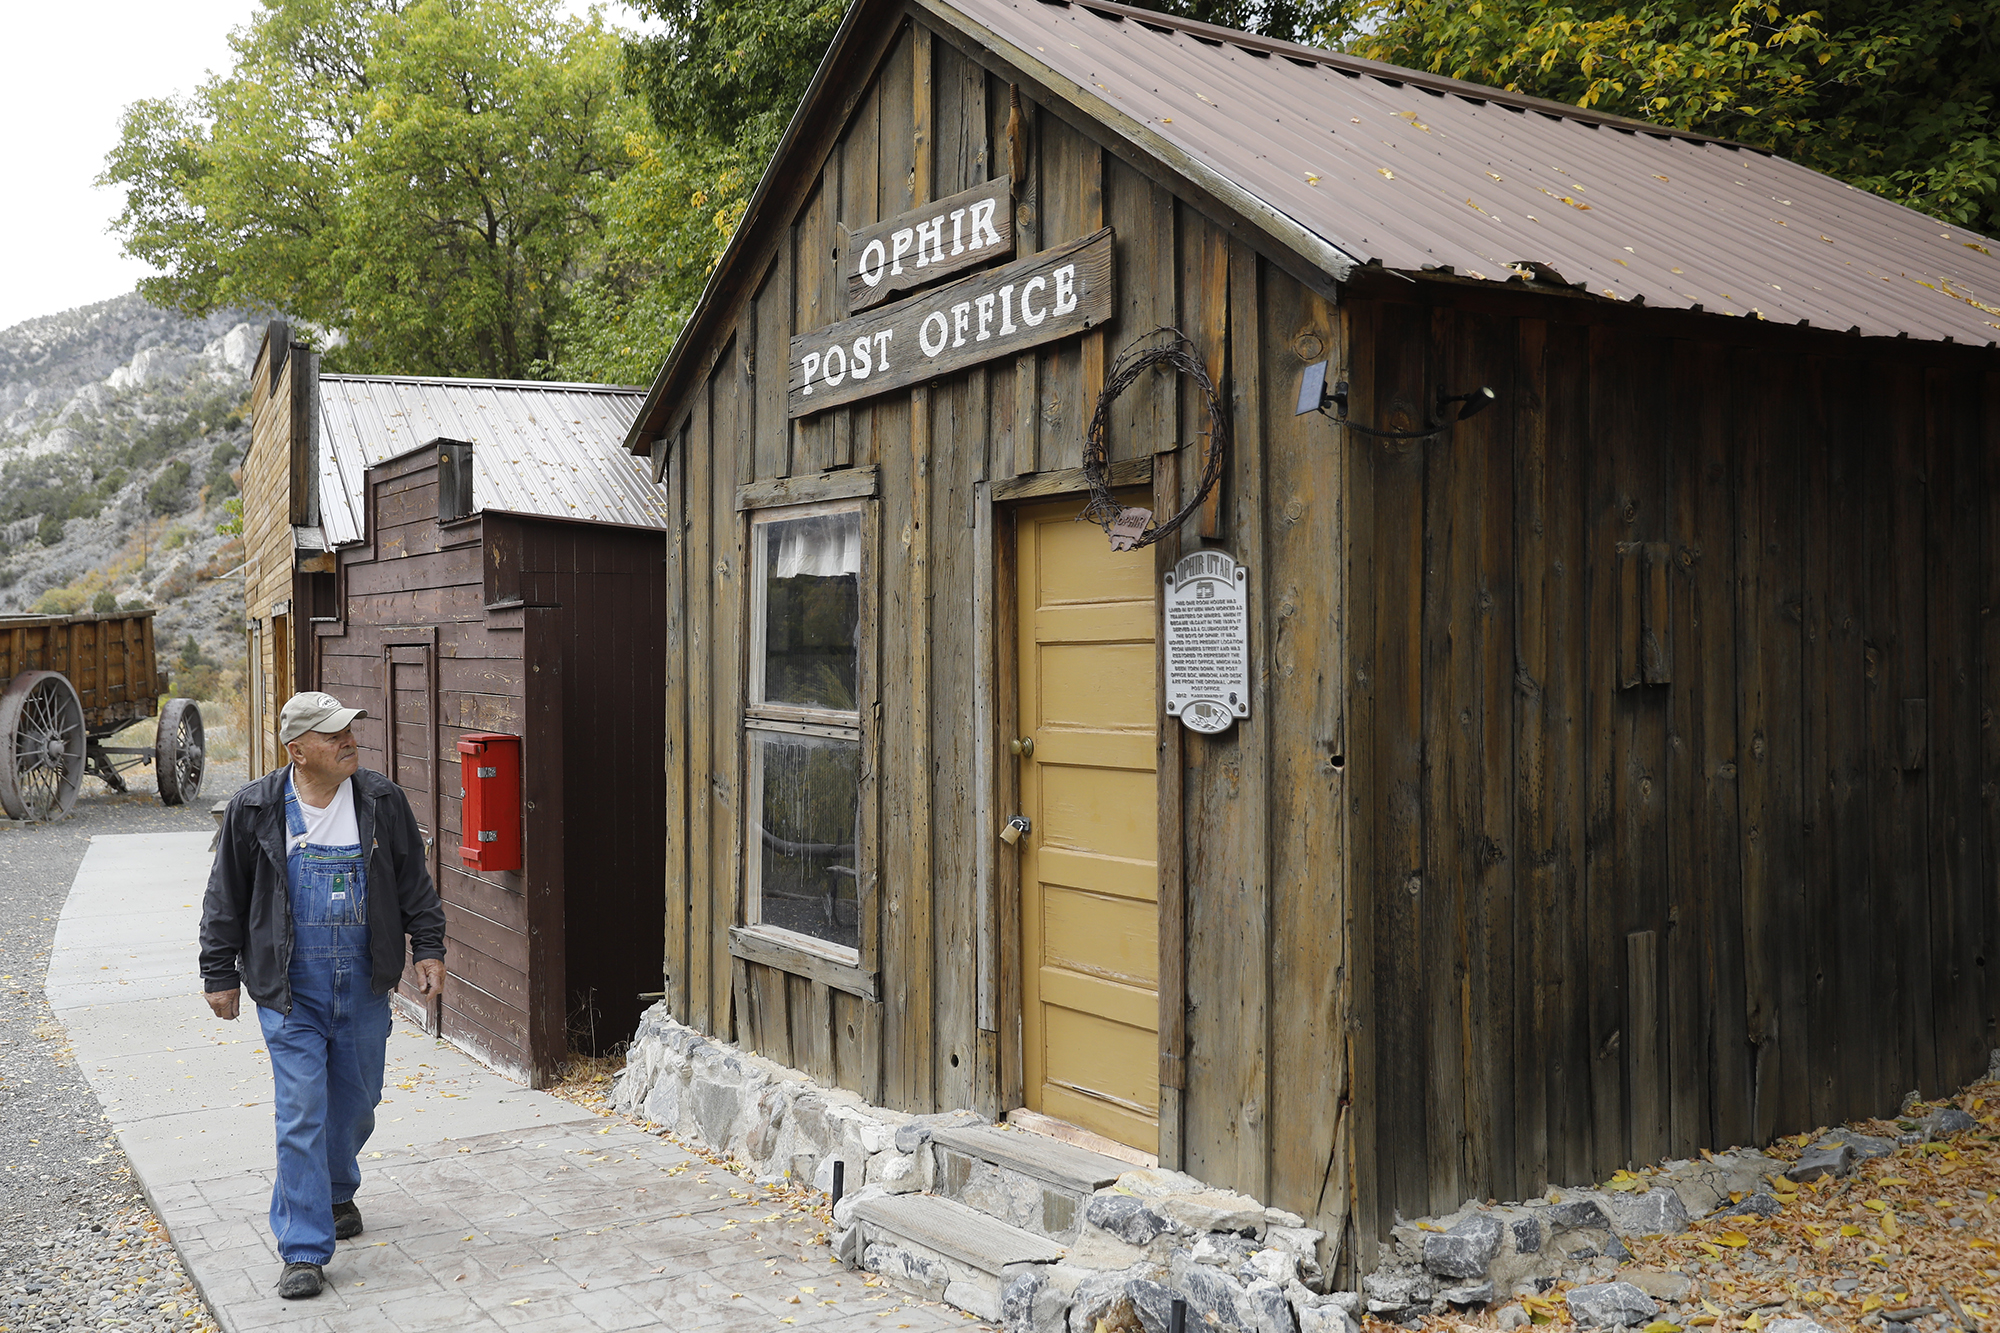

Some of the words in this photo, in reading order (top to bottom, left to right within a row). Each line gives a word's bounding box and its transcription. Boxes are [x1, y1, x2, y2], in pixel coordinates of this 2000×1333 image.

[859, 198, 1000, 287] OPHIR
[801, 329, 893, 395] POST
[919, 264, 1077, 357] OFFICE
[1118, 516, 1145, 528] OPHIR
[1179, 555, 1204, 582] OPHIR
[1207, 554, 1230, 580] UTAH
